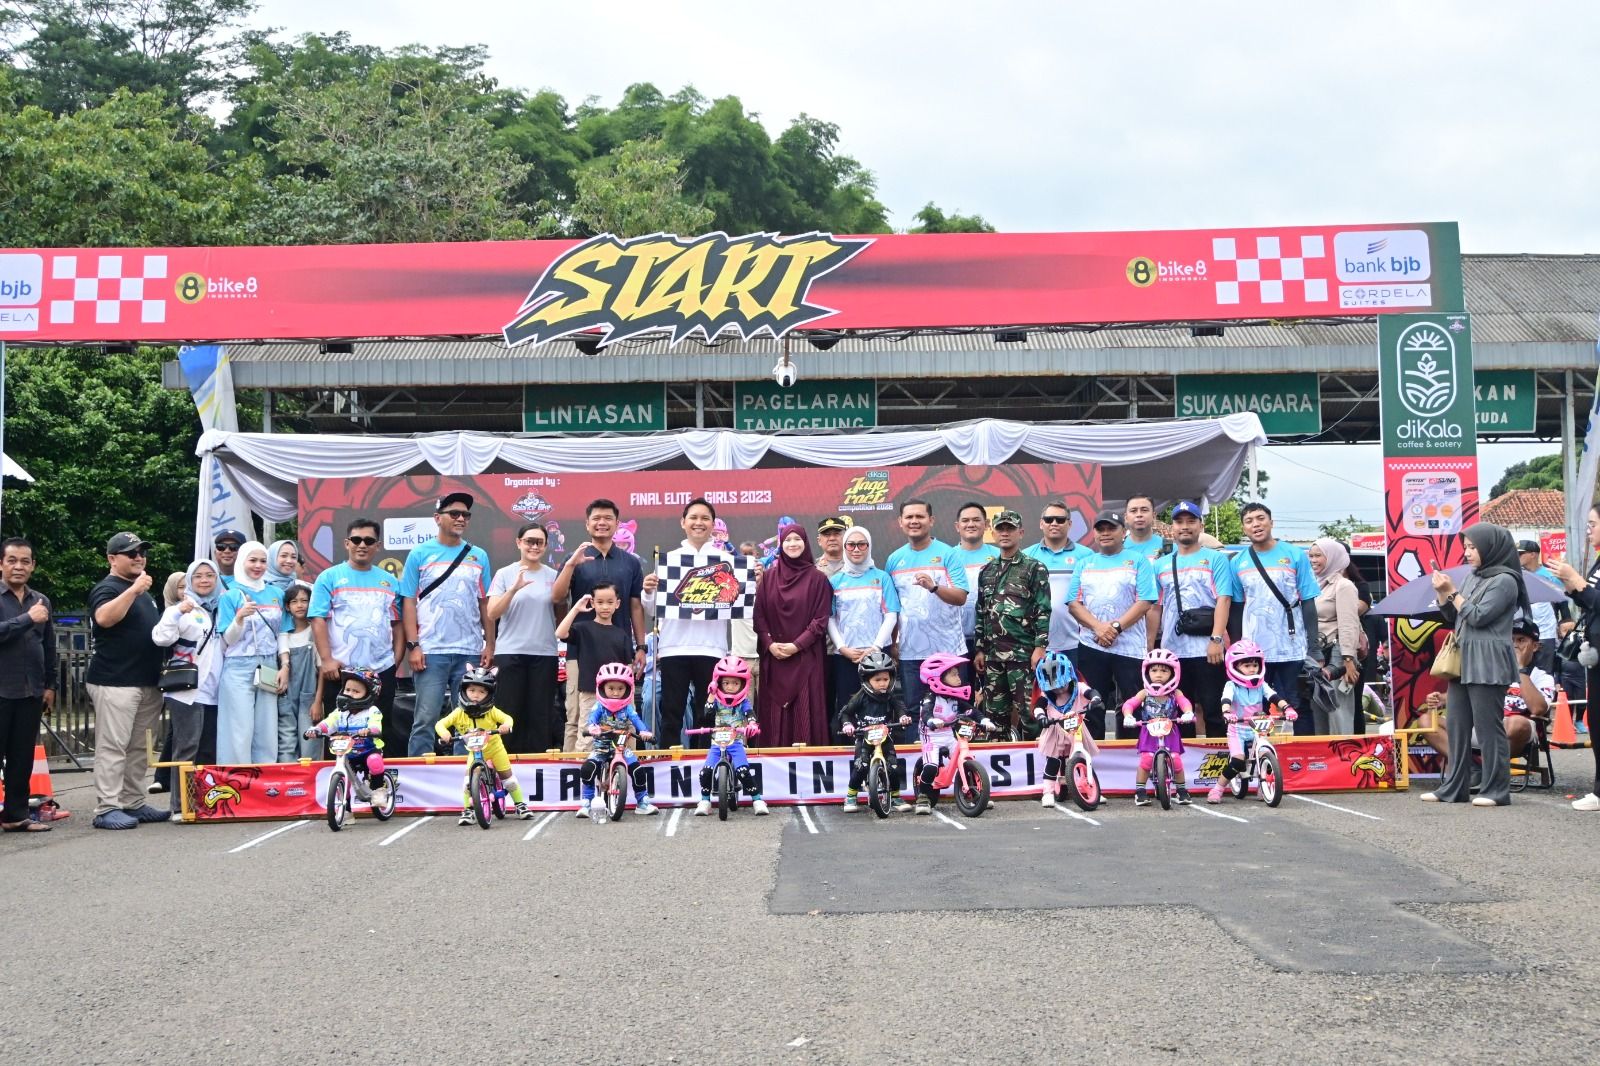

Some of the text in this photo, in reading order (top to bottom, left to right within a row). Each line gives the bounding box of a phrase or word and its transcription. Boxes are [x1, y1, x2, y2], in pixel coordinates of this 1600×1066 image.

[1158, 260, 1207, 276] bike8
[1345, 256, 1421, 275] bank bjb
[1, 280, 32, 299] bjb
[207, 276, 258, 293] bike8
[515, 240, 844, 327] START
[1342, 288, 1428, 299] CORDELA
[742, 393, 870, 410] PAGELARAN
[1182, 393, 1314, 415] SUKANAGARA
[535, 404, 653, 424] LINTASAN
[1396, 419, 1462, 439] diKala
[1397, 440, 1462, 449] coffee & eatery
[504, 477, 544, 488] Organized
[630, 490, 772, 505] FINAL ELITE GIRLS 2023
[389, 534, 415, 545] bank
